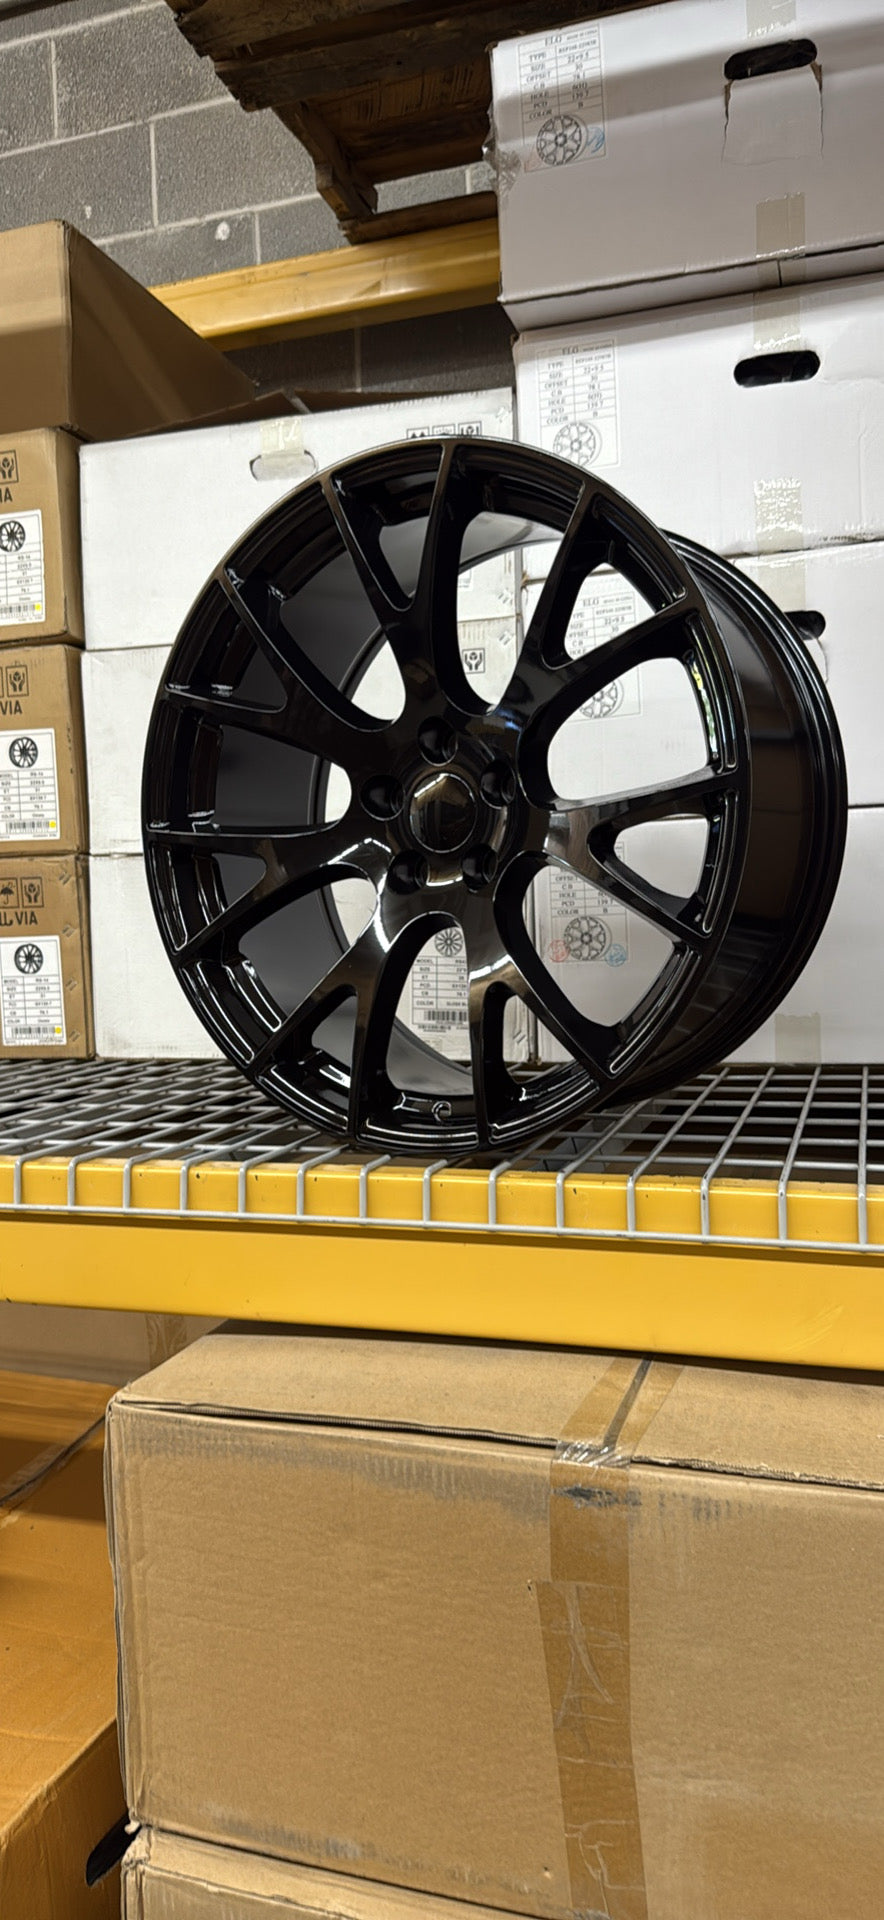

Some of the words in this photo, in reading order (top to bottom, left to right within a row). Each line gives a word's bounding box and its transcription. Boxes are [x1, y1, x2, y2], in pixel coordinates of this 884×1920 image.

[530, 52, 546, 62] TYPE
[534, 101, 548, 109] PCD
[548, 361, 563, 370] TYPE
[0, 700, 23, 715] VIA
